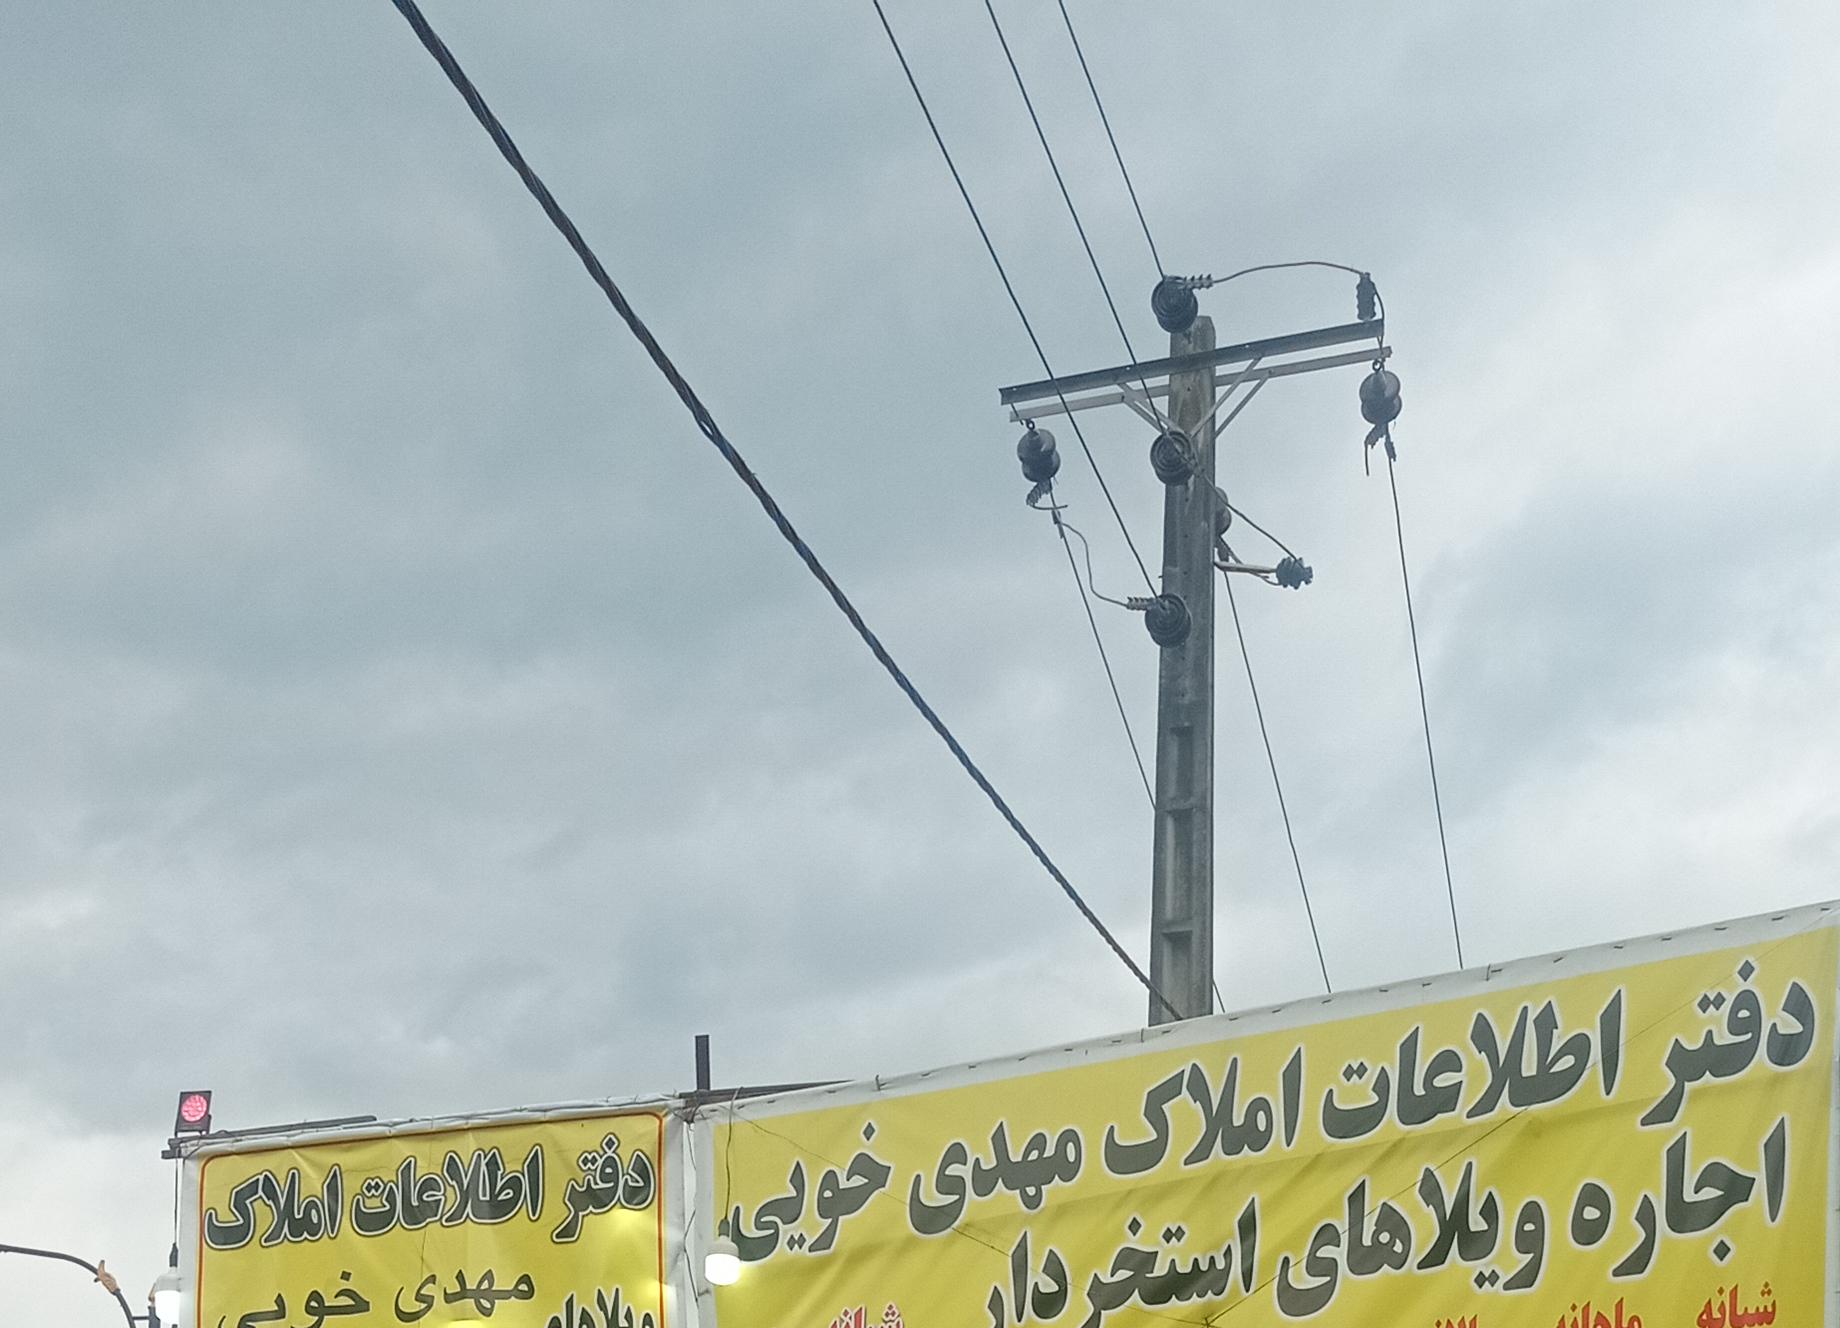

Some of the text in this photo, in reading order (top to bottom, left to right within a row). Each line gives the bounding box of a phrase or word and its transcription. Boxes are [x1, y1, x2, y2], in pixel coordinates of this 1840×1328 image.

[731, 959, 1815, 1263] دفتر اطلاعات املاک مهدی خویی
[205, 1133, 655, 1250] دفتر اطلاعات املاک
[1276, 1160, 1545, 1318] ویلاهای
[1572, 1116, 1786, 1279] اجاره
[395, 1269, 535, 1318] مهدی
